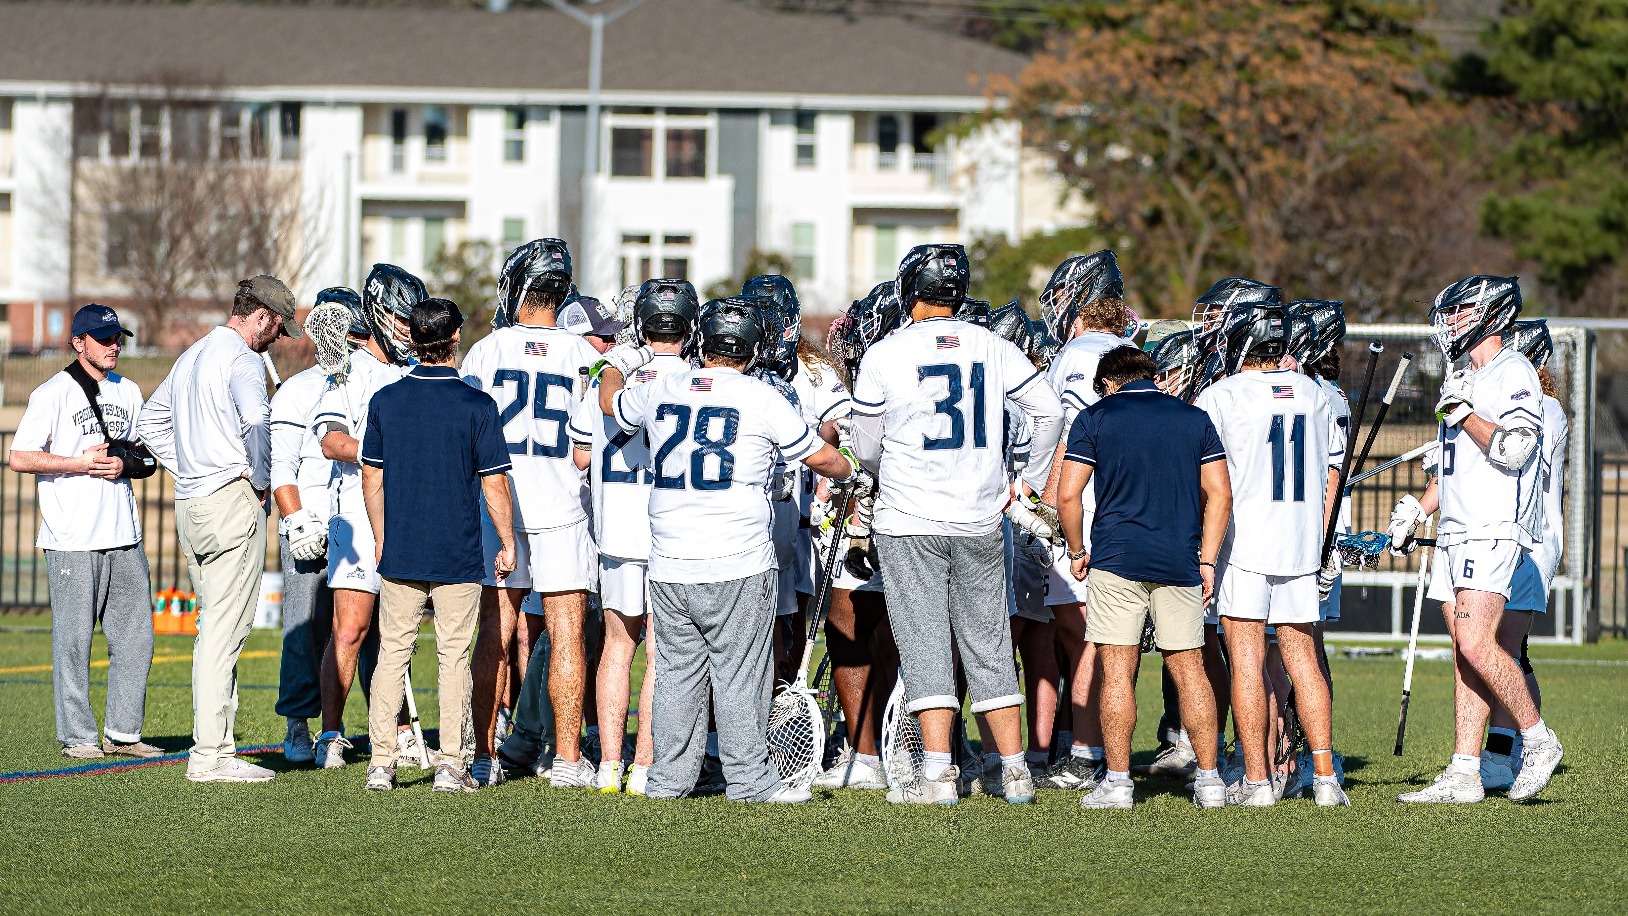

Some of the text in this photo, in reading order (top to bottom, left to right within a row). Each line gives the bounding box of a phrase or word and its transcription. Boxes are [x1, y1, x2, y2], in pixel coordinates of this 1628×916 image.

[492, 367, 574, 459] 25
[654, 402, 741, 491] 28
[916, 361, 988, 451] 31
[1266, 413, 1306, 502] 11
[1463, 558, 1475, 579] 6
